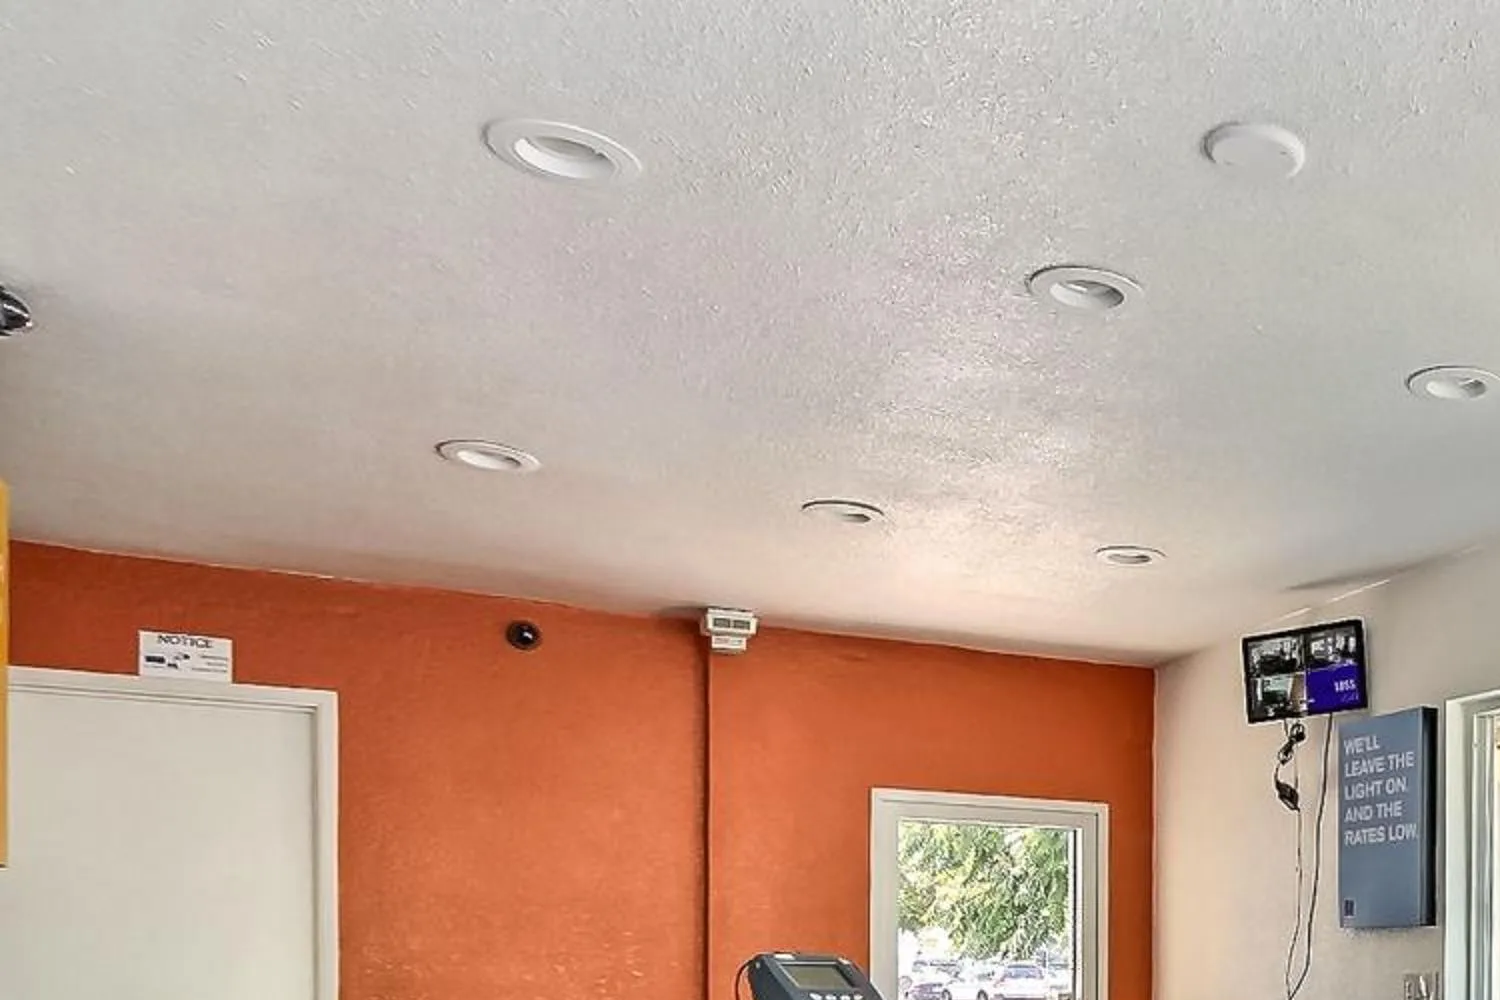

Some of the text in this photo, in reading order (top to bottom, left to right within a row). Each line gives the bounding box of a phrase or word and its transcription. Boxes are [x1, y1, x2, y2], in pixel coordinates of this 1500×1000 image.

[158, 635, 213, 648] NOTICE
[1344, 751, 1415, 777] LEAVE THE
[1344, 780, 1383, 800] LIGHT
[1344, 800, 1403, 823] AND THE
[1344, 826, 1386, 845] RATES
